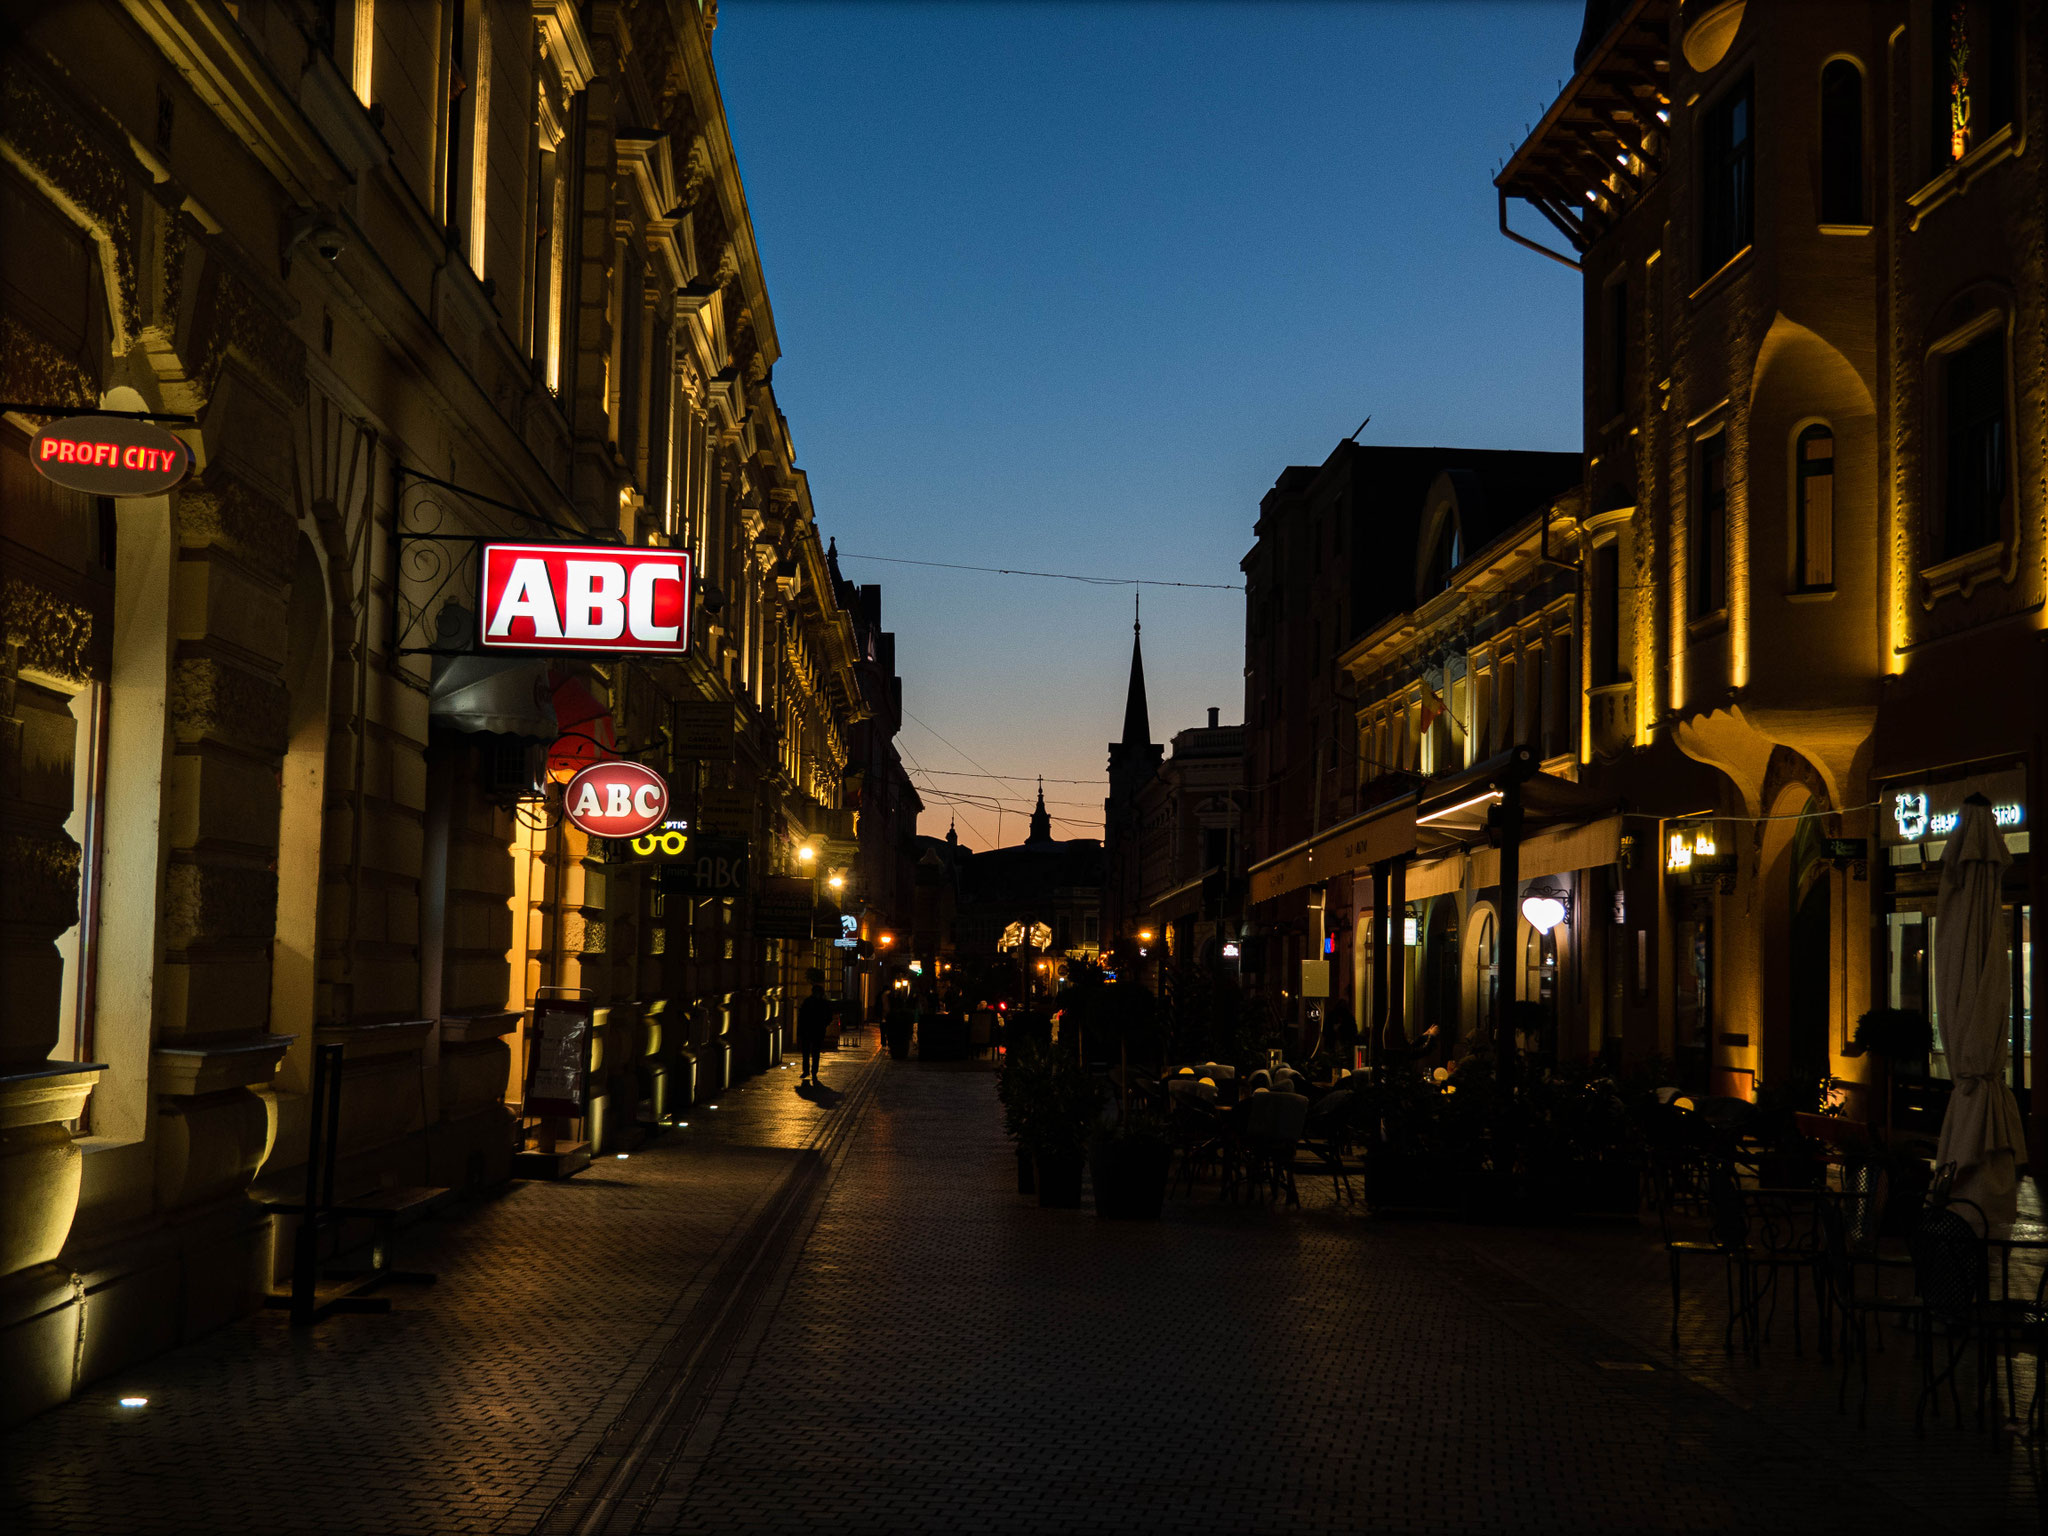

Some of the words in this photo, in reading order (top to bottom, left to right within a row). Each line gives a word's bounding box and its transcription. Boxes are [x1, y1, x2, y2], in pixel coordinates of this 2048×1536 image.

[41, 438, 119, 467] PROFI
[123, 446, 176, 472] CITY
[488, 558, 681, 641] ABC
[573, 782, 661, 818] ABC
[1992, 804, 2019, 825] STRO
[693, 856, 741, 888] ABC
